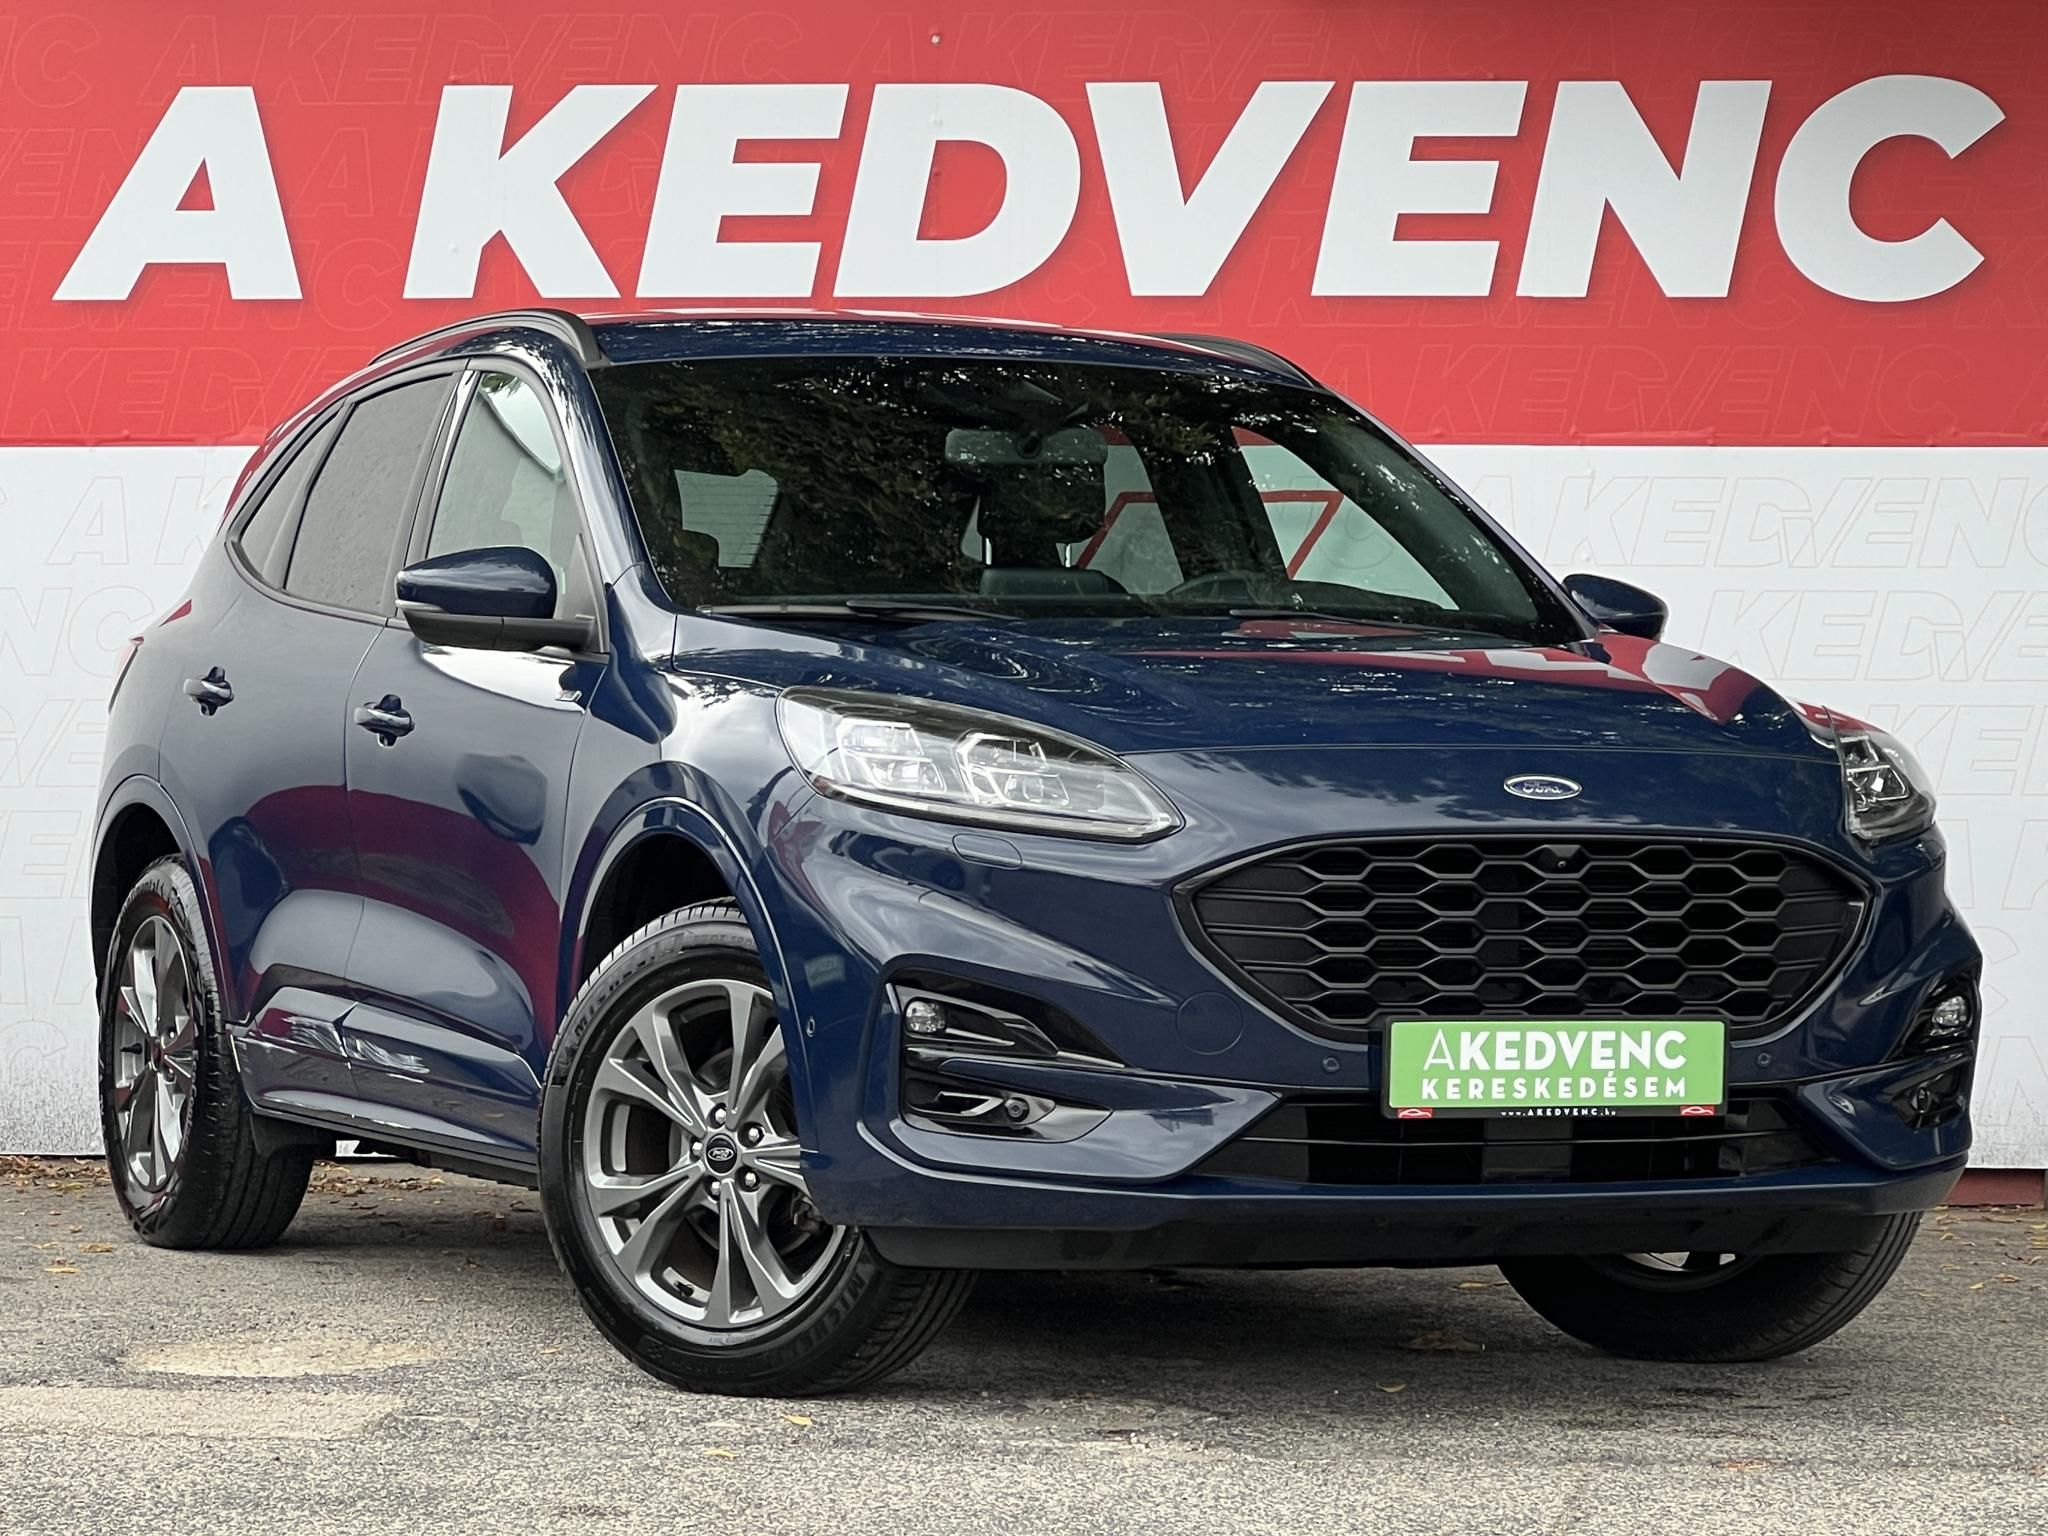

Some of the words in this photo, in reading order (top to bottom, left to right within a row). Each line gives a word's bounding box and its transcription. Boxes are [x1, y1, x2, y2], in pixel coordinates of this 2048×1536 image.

[52, 84, 302, 302] A
[401, 74, 2006, 303] KEDVENC
[1423, 1028, 1687, 1071] AKEDVENC
[1422, 1071, 1686, 1100] KERESKEDÉSEM
